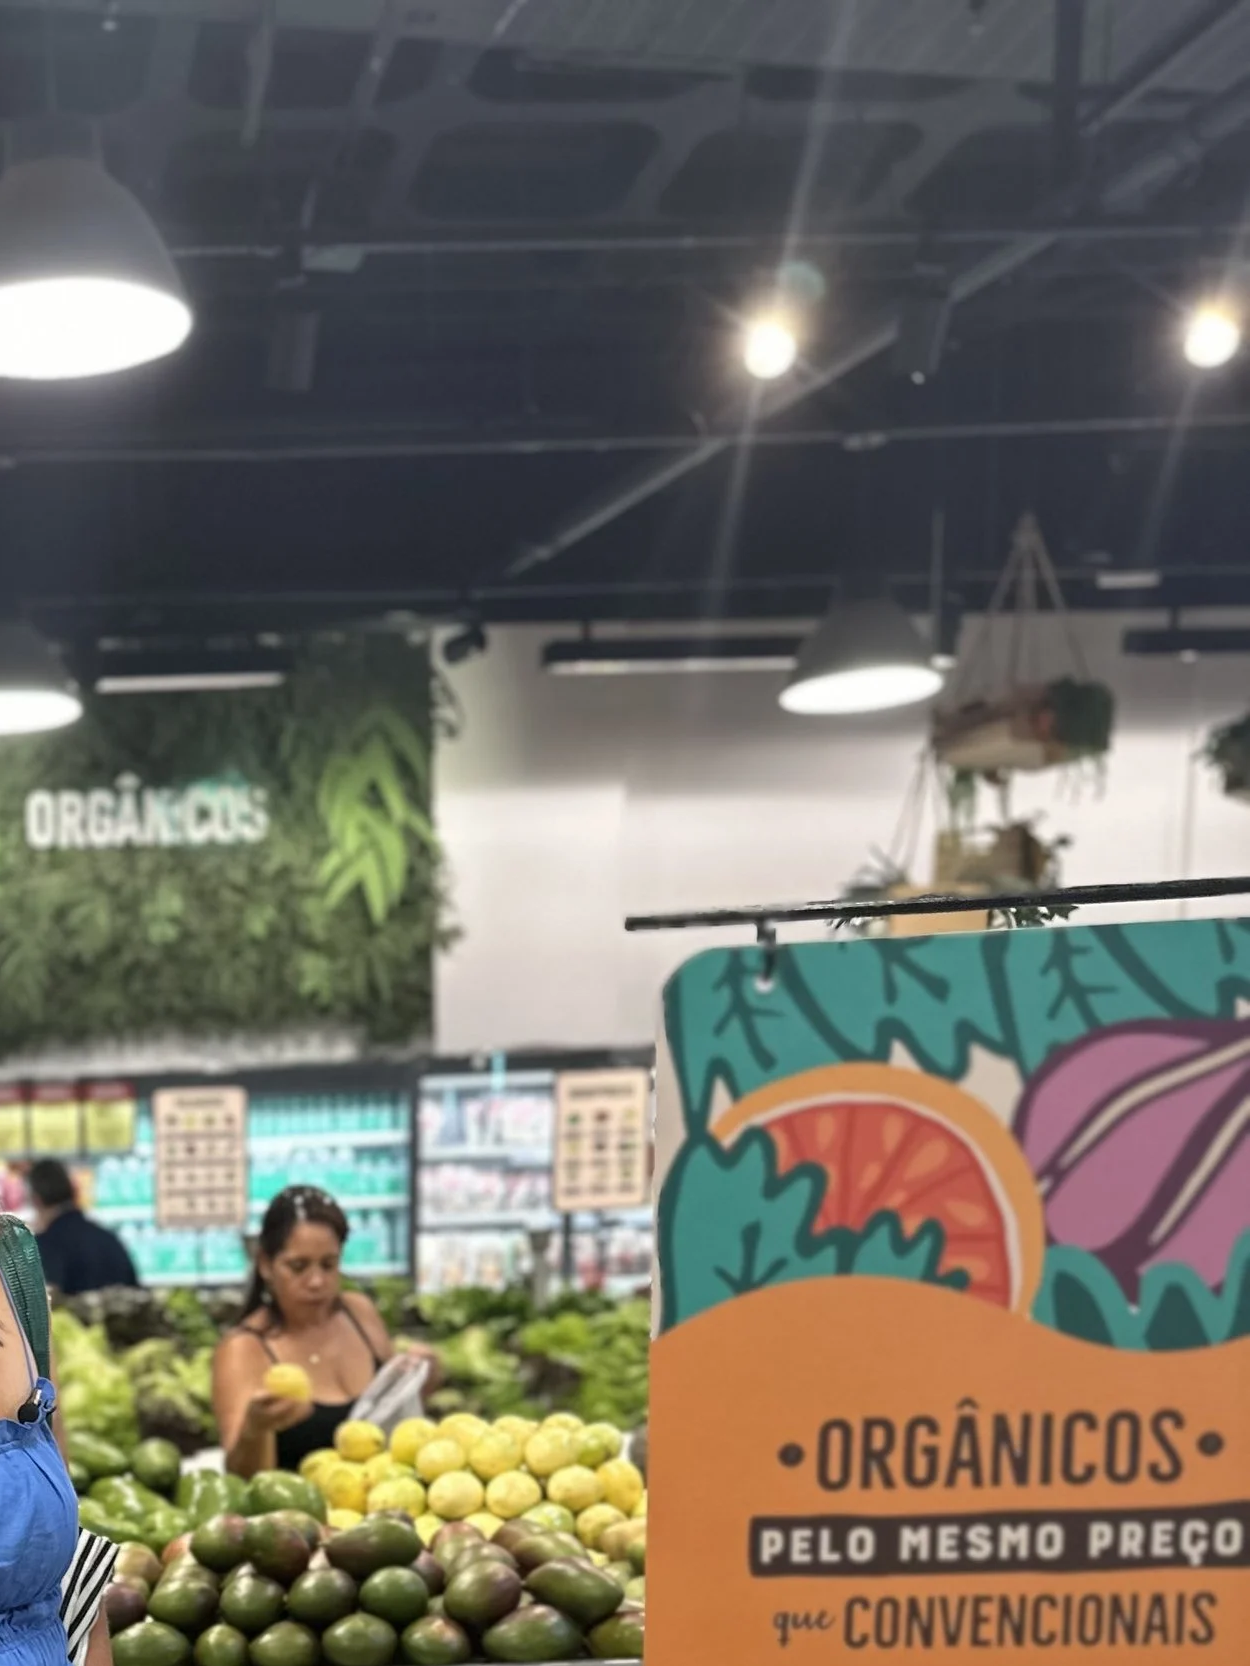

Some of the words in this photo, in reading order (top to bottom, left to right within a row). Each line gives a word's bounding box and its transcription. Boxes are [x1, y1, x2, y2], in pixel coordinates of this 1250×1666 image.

[816, 1397, 1185, 1492] ORGÂNICOS
[759, 1527, 876, 1564] PELO
[899, 1523, 1066, 1563] MESMO
[1088, 1518, 1245, 1567] PREÇO
[772, 1608, 836, 1648] que
[843, 1591, 1219, 1650] CONVENCIONAIS
